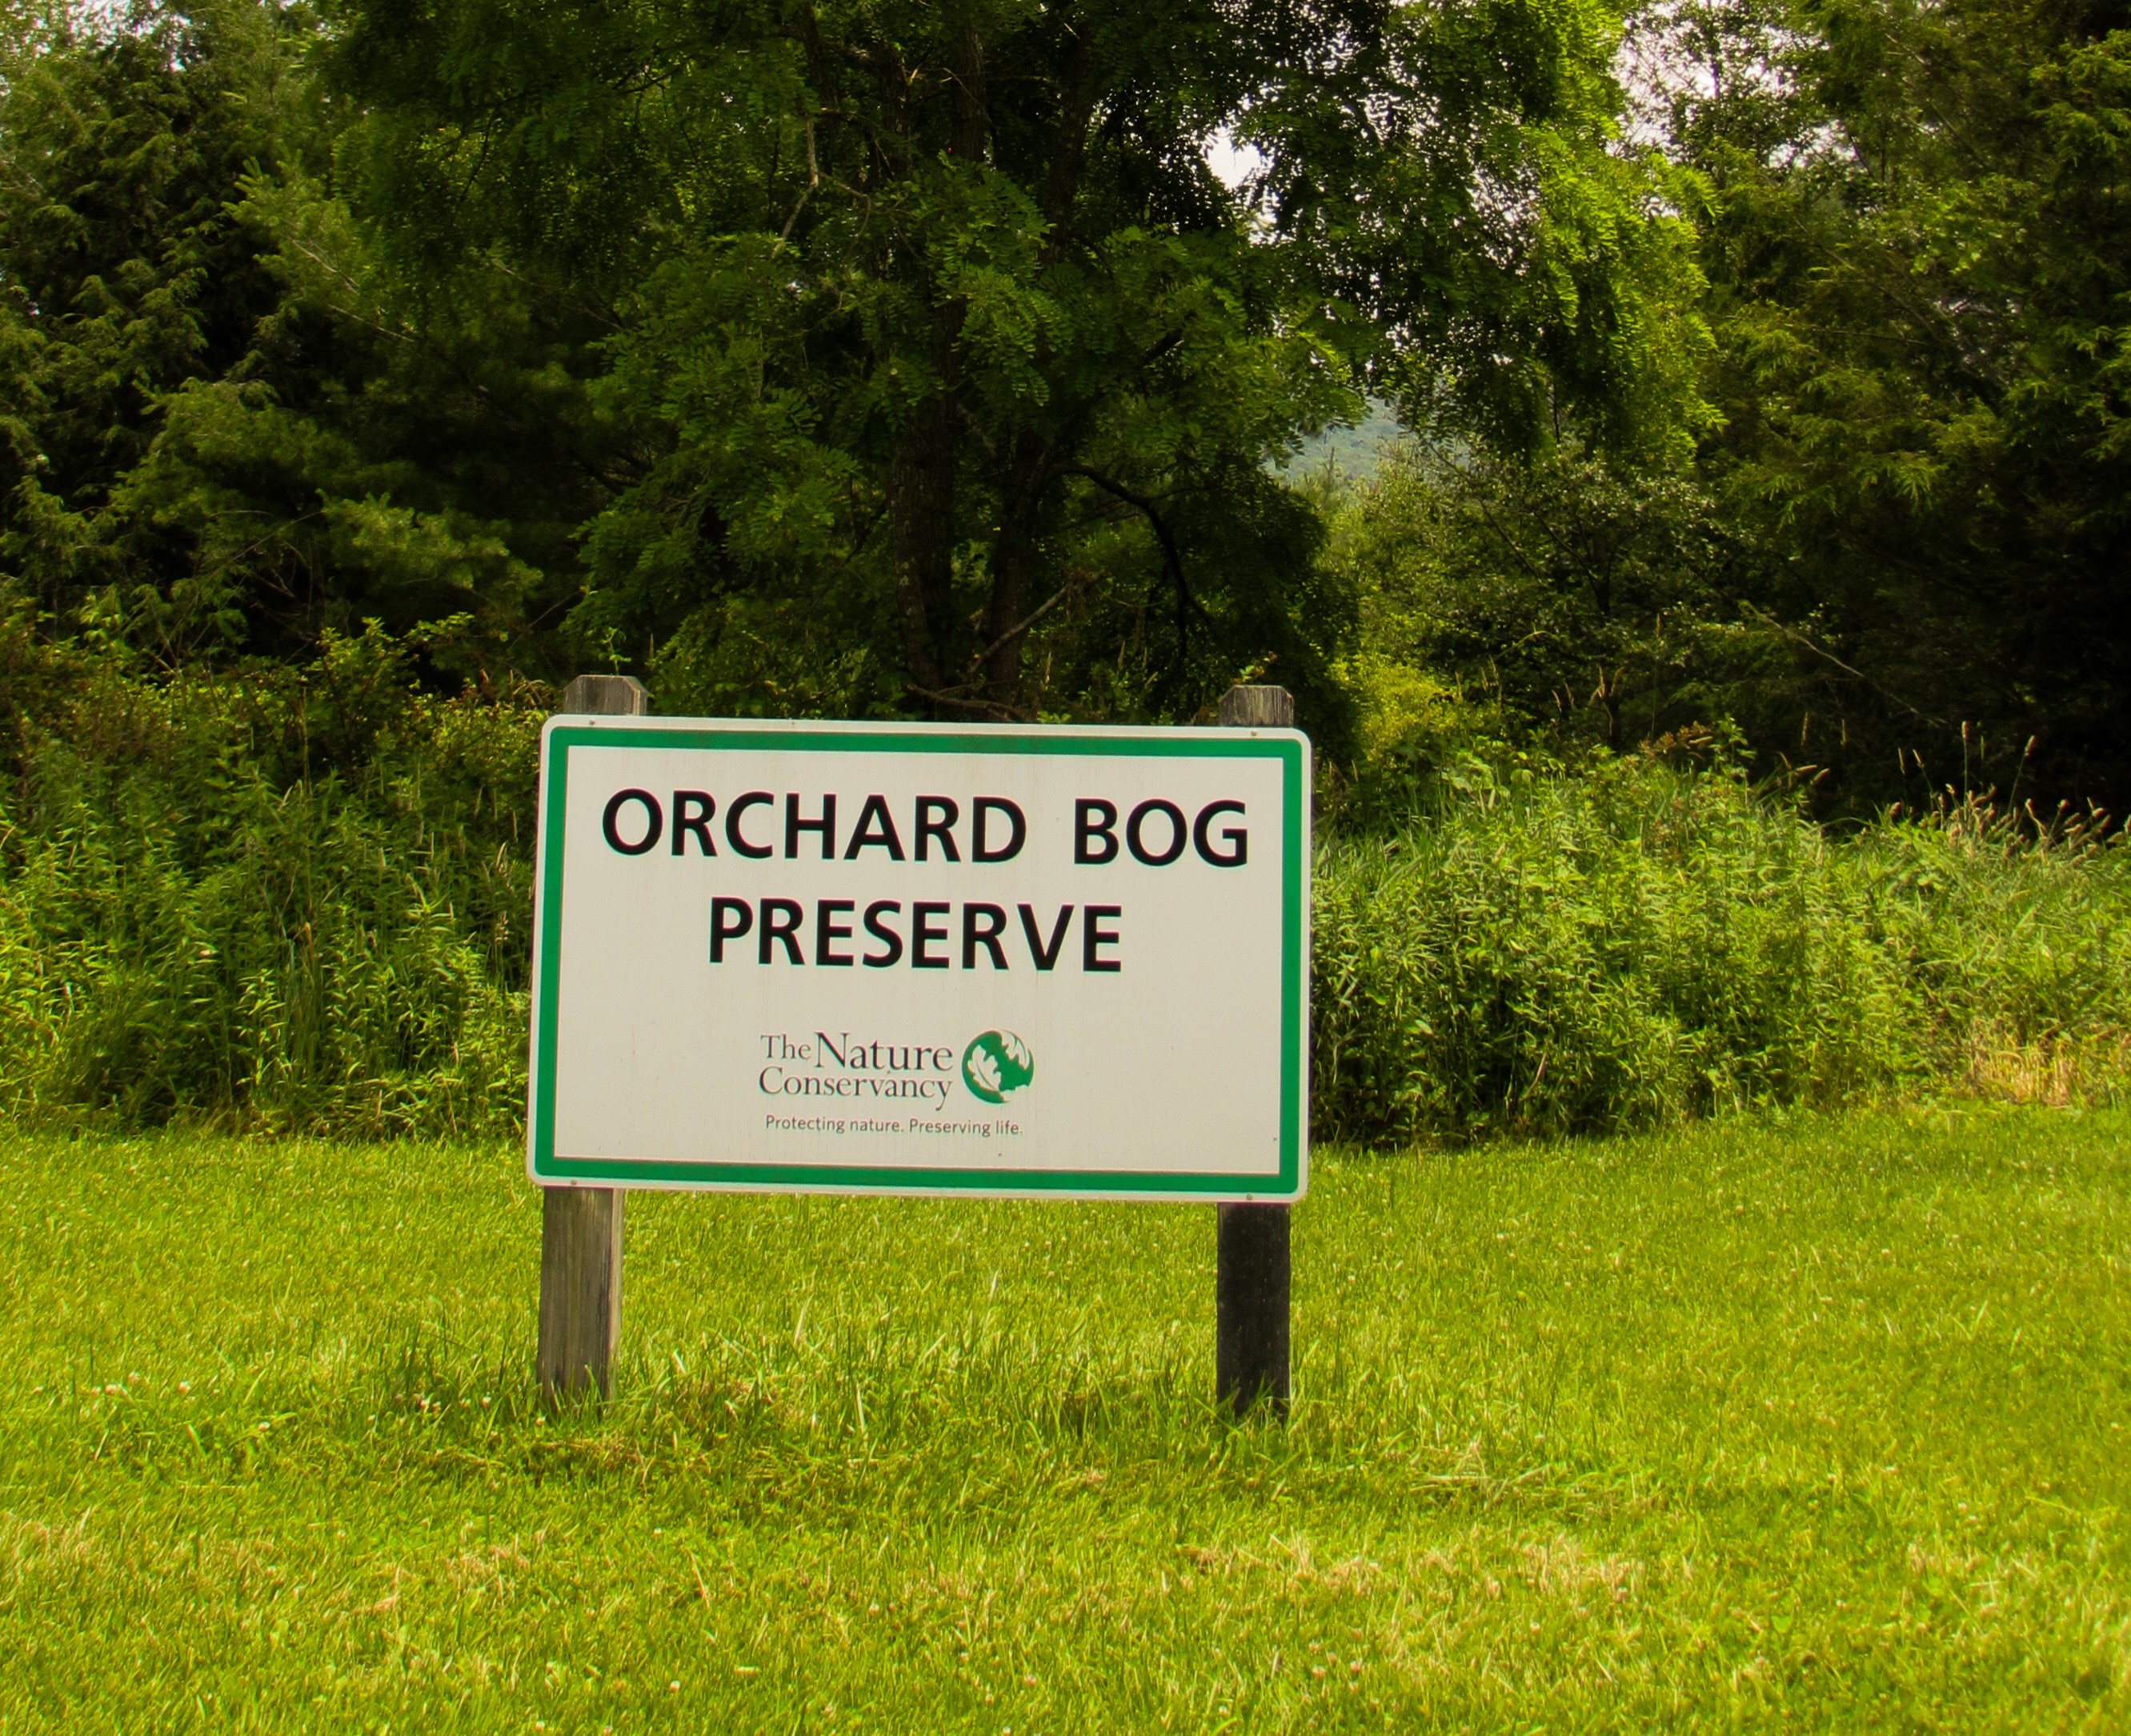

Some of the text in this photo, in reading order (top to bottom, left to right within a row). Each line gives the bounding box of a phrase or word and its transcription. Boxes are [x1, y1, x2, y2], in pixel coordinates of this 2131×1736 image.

[602, 788, 1248, 868] ORCHARD BOG
[709, 896, 1122, 973] PRESERVE
[760, 1032, 953, 1071] The Nature
[759, 1066, 952, 1112] Conservancy
[766, 1114, 845, 1134] Protecting
[850, 1118, 904, 1133] nature.
[909, 1118, 991, 1138] Preserving
